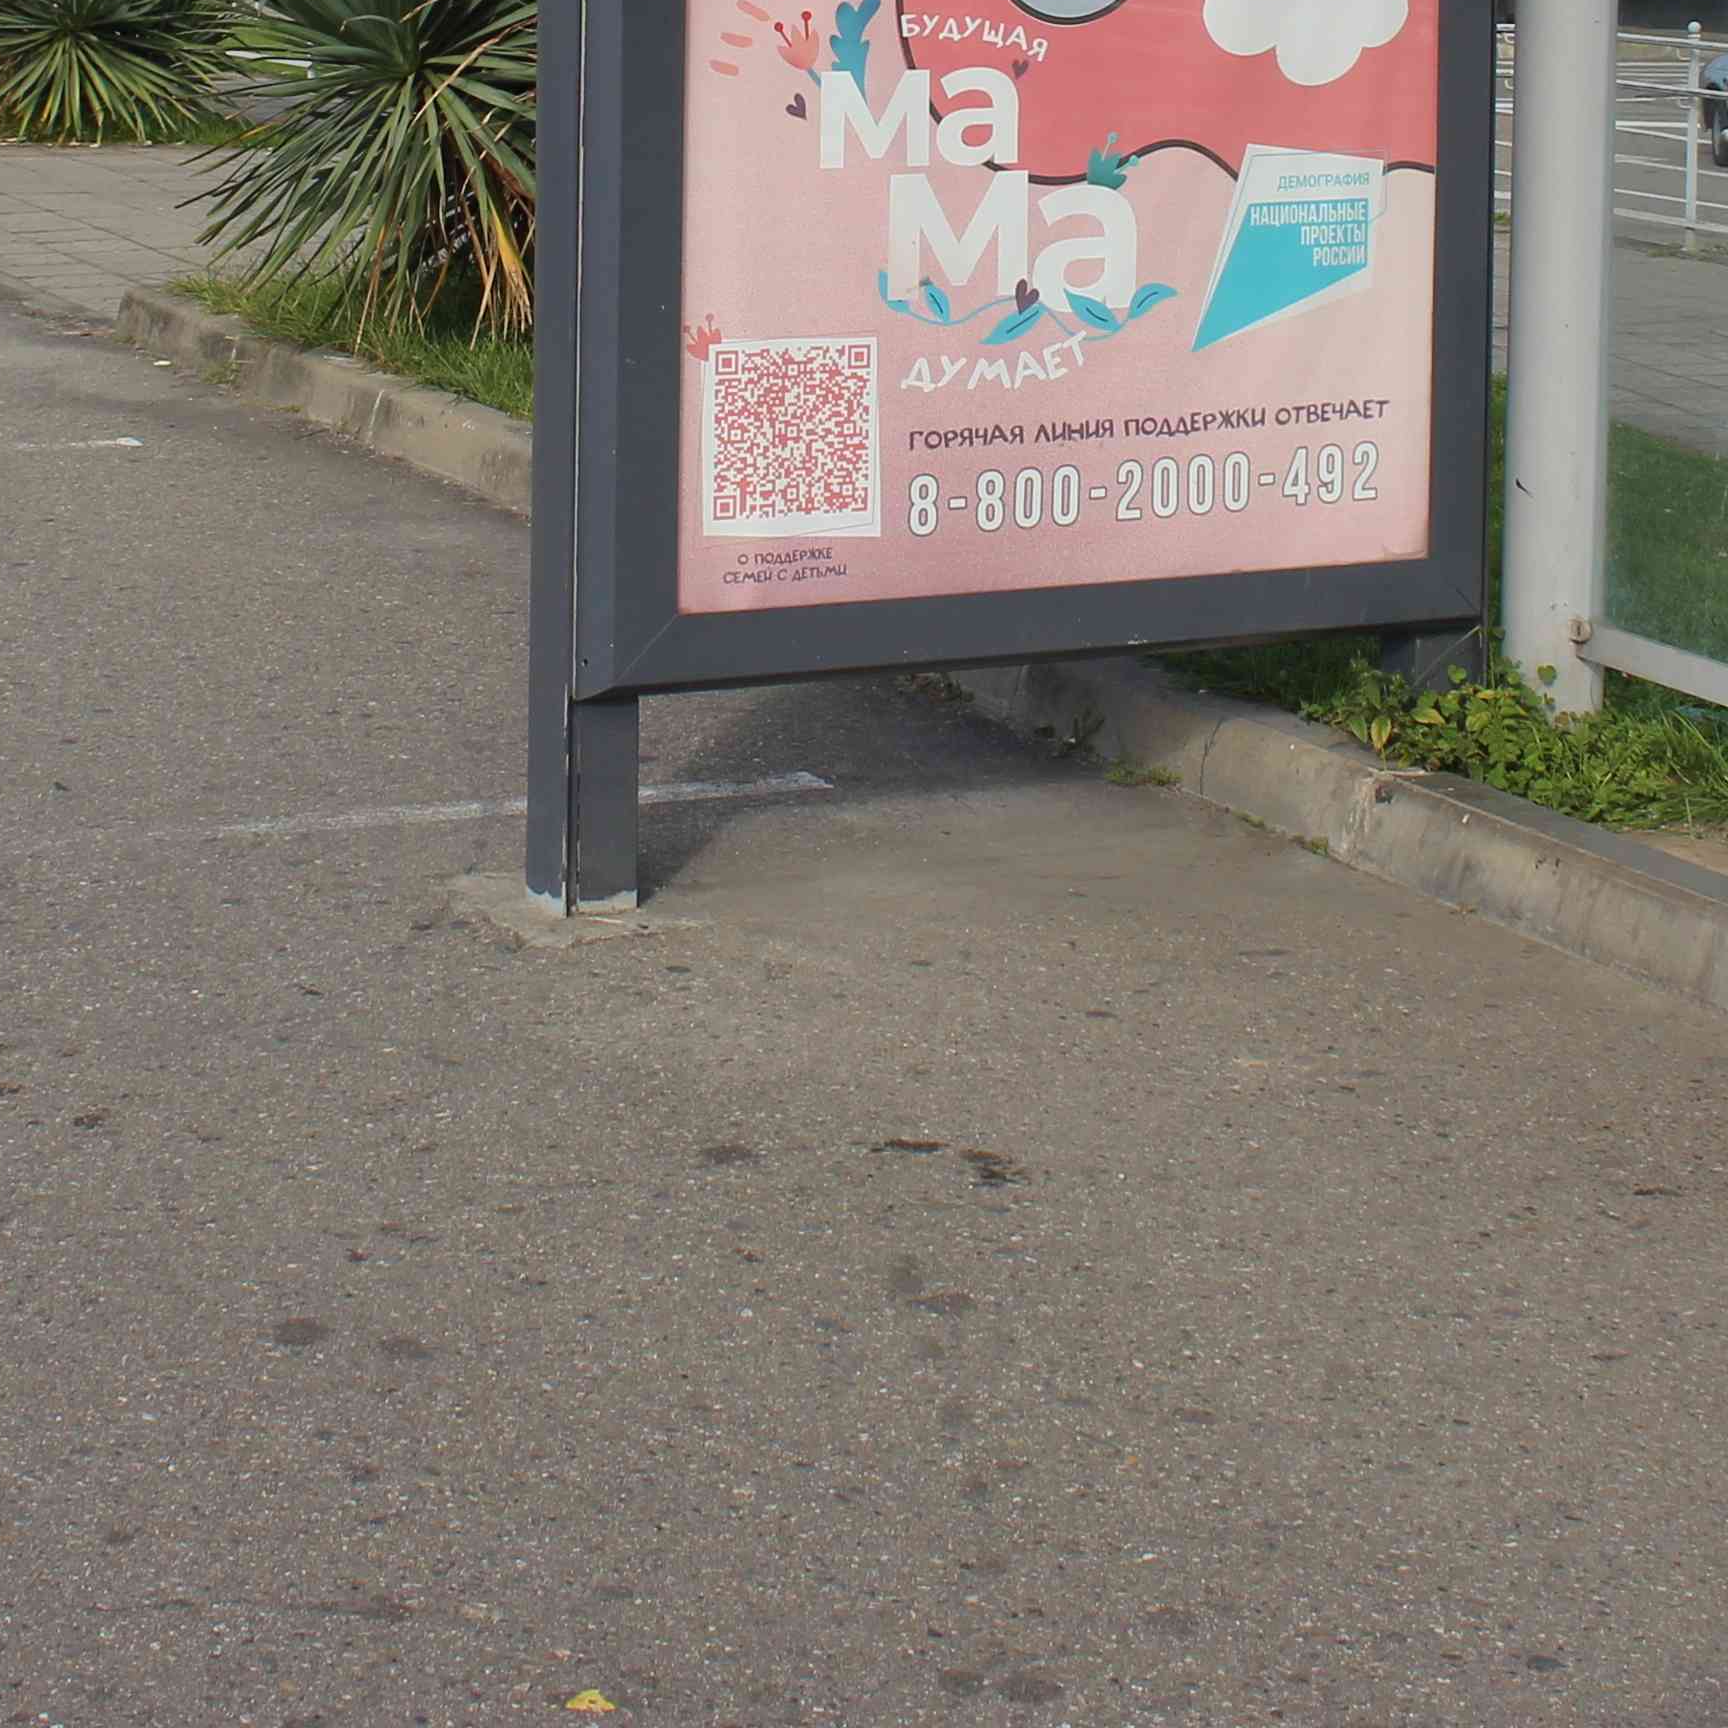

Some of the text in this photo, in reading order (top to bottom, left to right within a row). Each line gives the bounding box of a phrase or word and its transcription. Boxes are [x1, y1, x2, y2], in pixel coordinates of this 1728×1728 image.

[901, 13, 1049, 62] БУДУЩАЯ
[1277, 171, 1370, 192] ДЕМОГРАФИЯ
[1249, 200, 1366, 227] НАЦИОНАЛЬНЫЕ
[1300, 223, 1366, 246] ПРОЕКТЫ
[1313, 245, 1365, 267] РОССИИ
[901, 330, 1088, 393] ДУМАЕТ
[908, 398, 1390, 452] ГОРЯЧАЯ ЛИНИЯ ПОДДЕРЖКИ ОТВЕЧАЕТ
[907, 440, 1381, 537] 8-800-2000-492
[737, 547, 833, 565] О ПОДДЕРЖКЕ
[777, 568, 788, 581] С
[792, 563, 848, 582] ДЕТЬМИ
